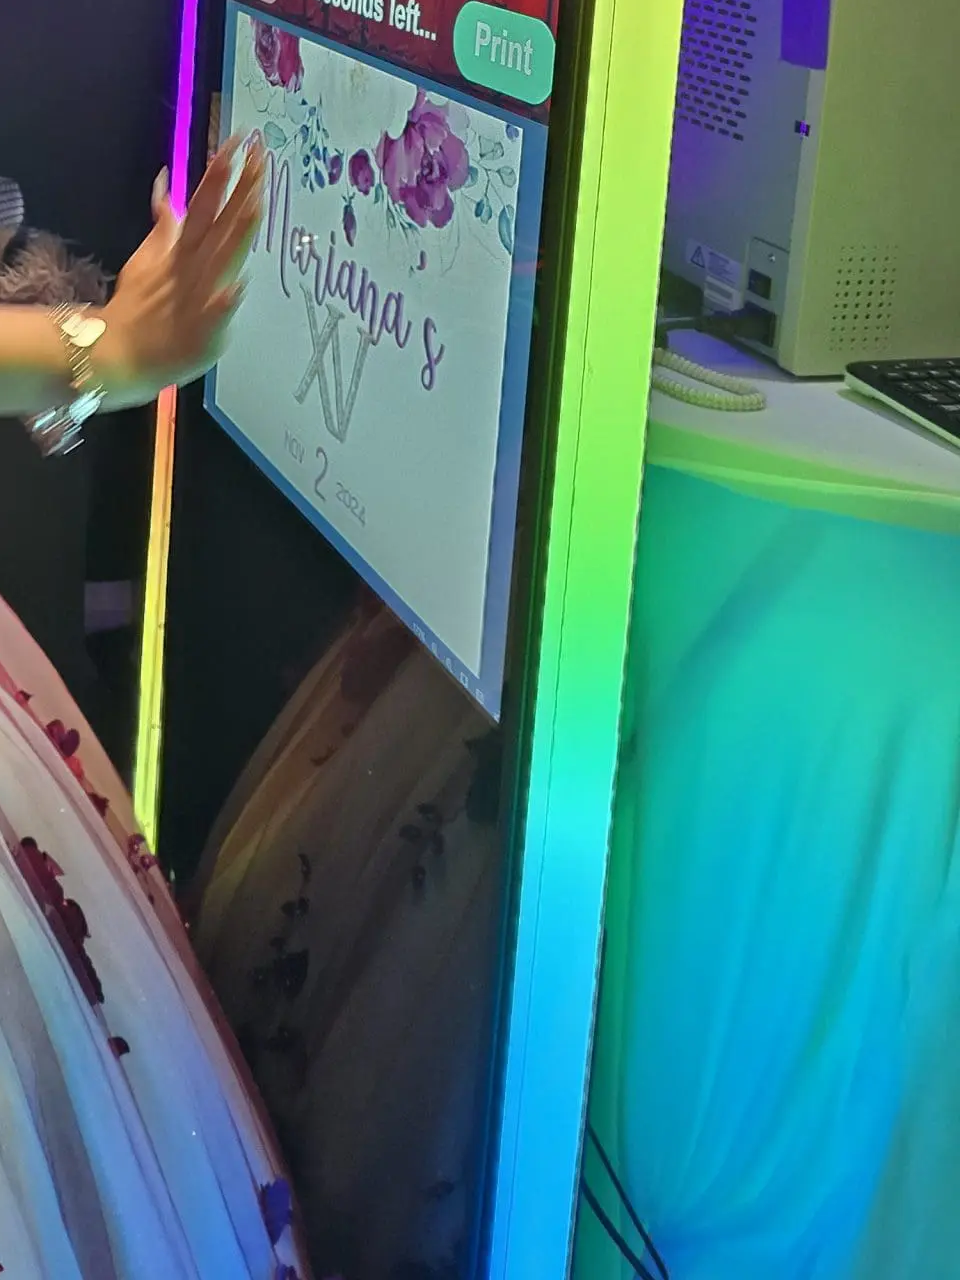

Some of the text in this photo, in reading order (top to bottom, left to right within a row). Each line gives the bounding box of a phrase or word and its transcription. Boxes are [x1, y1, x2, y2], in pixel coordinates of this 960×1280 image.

[474, 21, 534, 76] Print
[284, 428, 366, 528] NOV 2 2024
